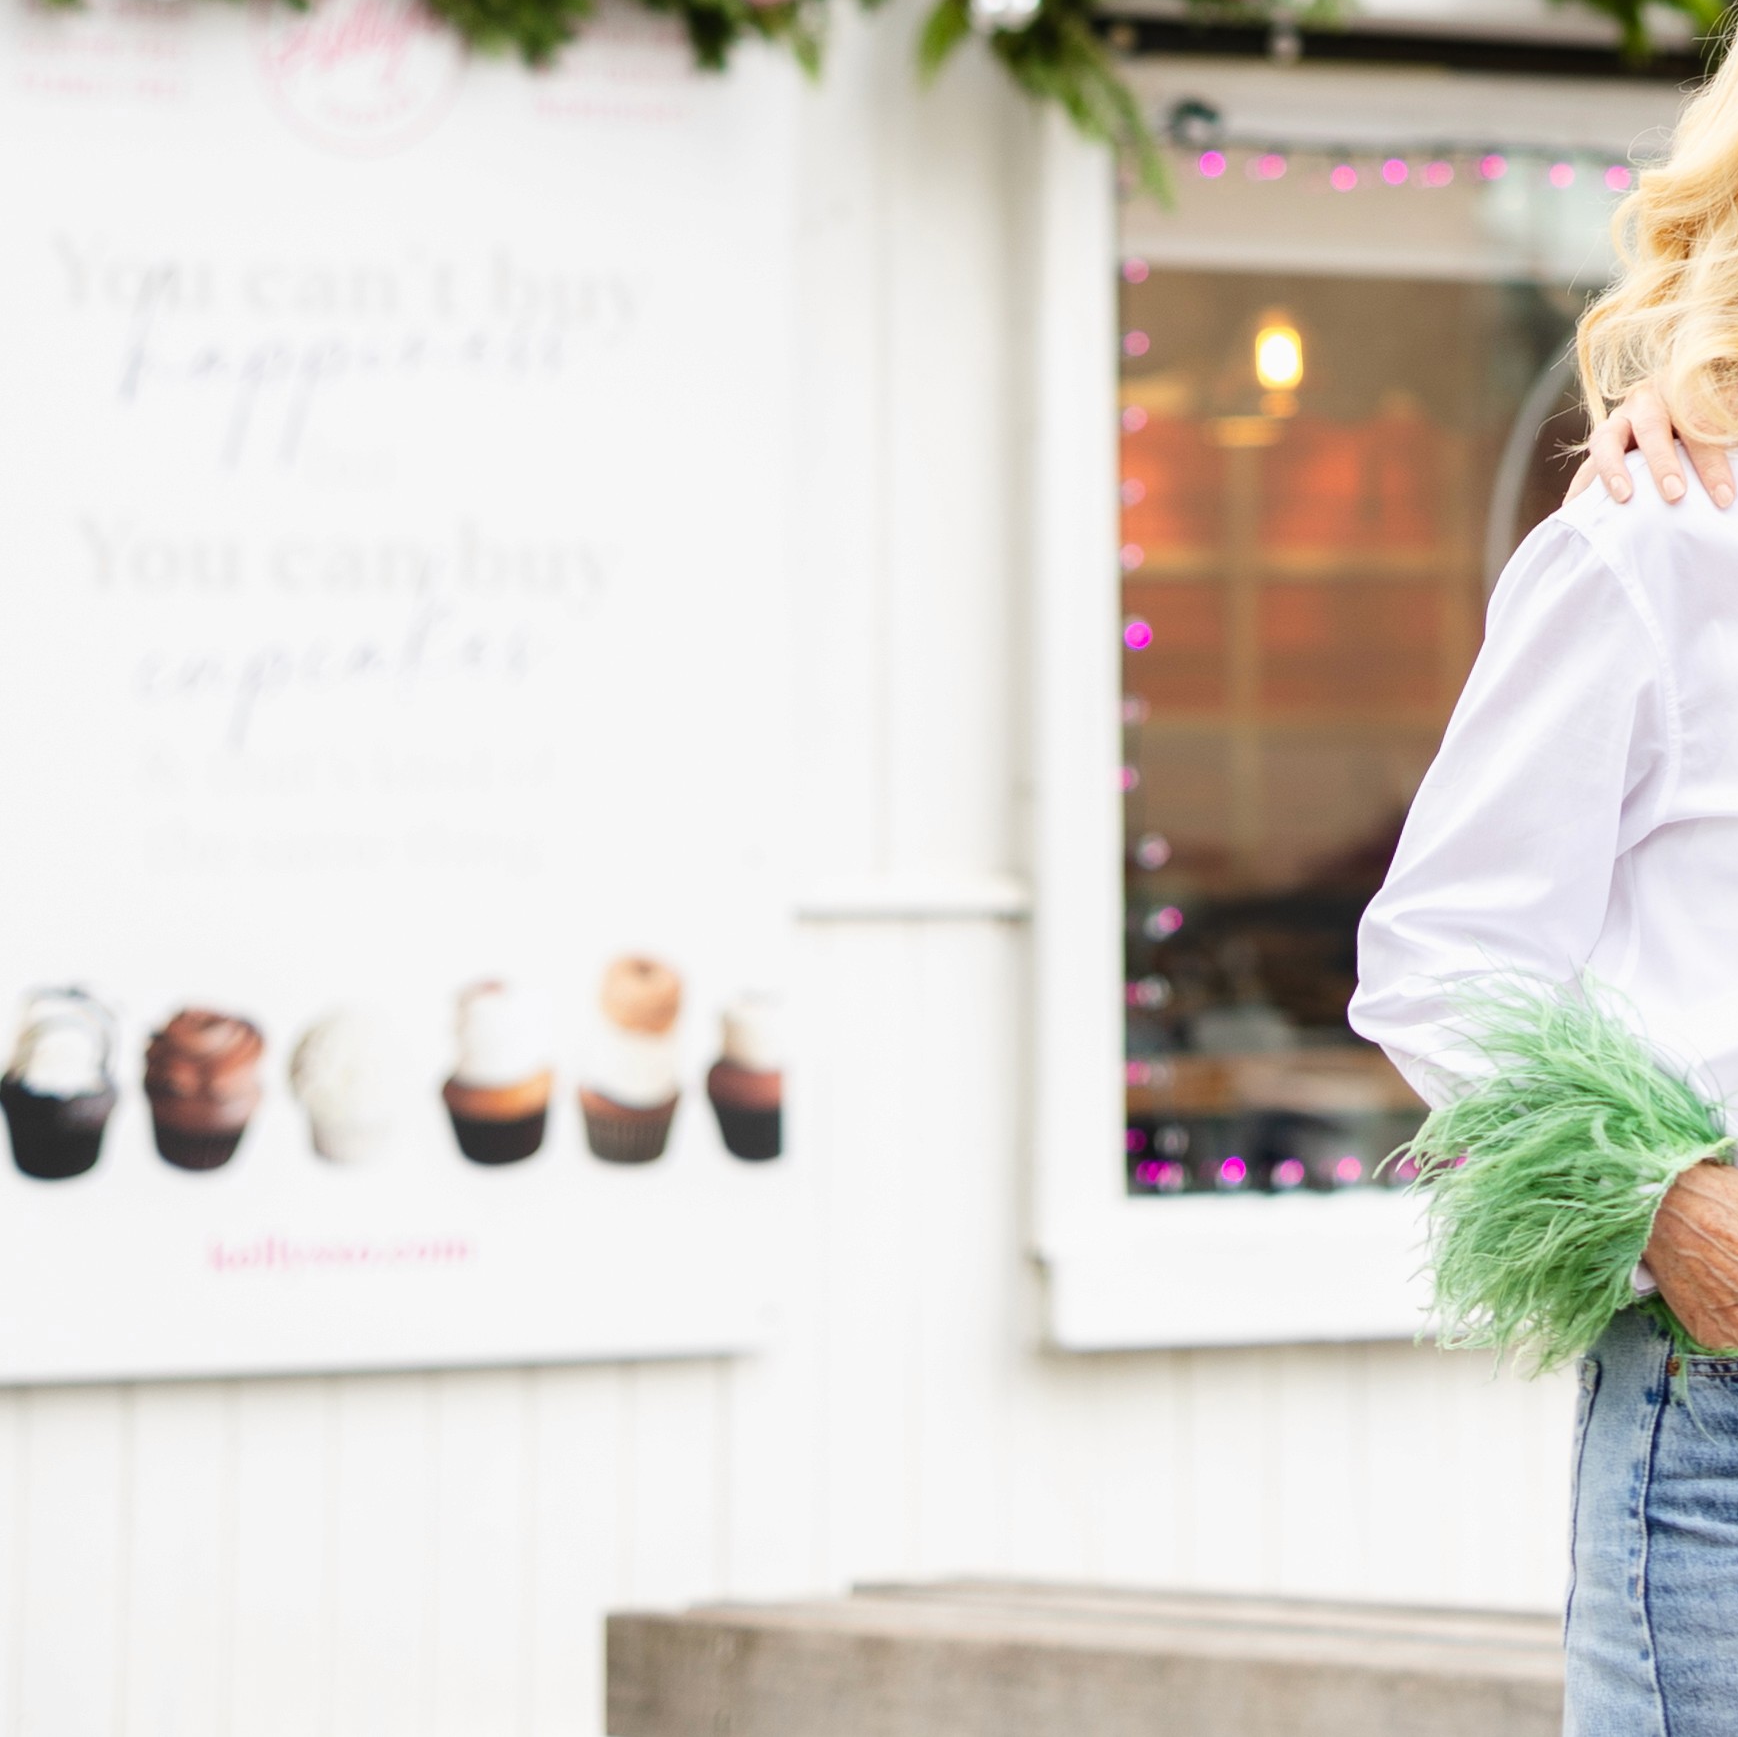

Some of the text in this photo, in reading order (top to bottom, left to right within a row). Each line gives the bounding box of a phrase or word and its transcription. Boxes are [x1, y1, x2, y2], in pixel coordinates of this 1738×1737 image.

[50, 225, 216, 315] You
[488, 240, 645, 352] buy
[74, 512, 623, 622] You can buy
